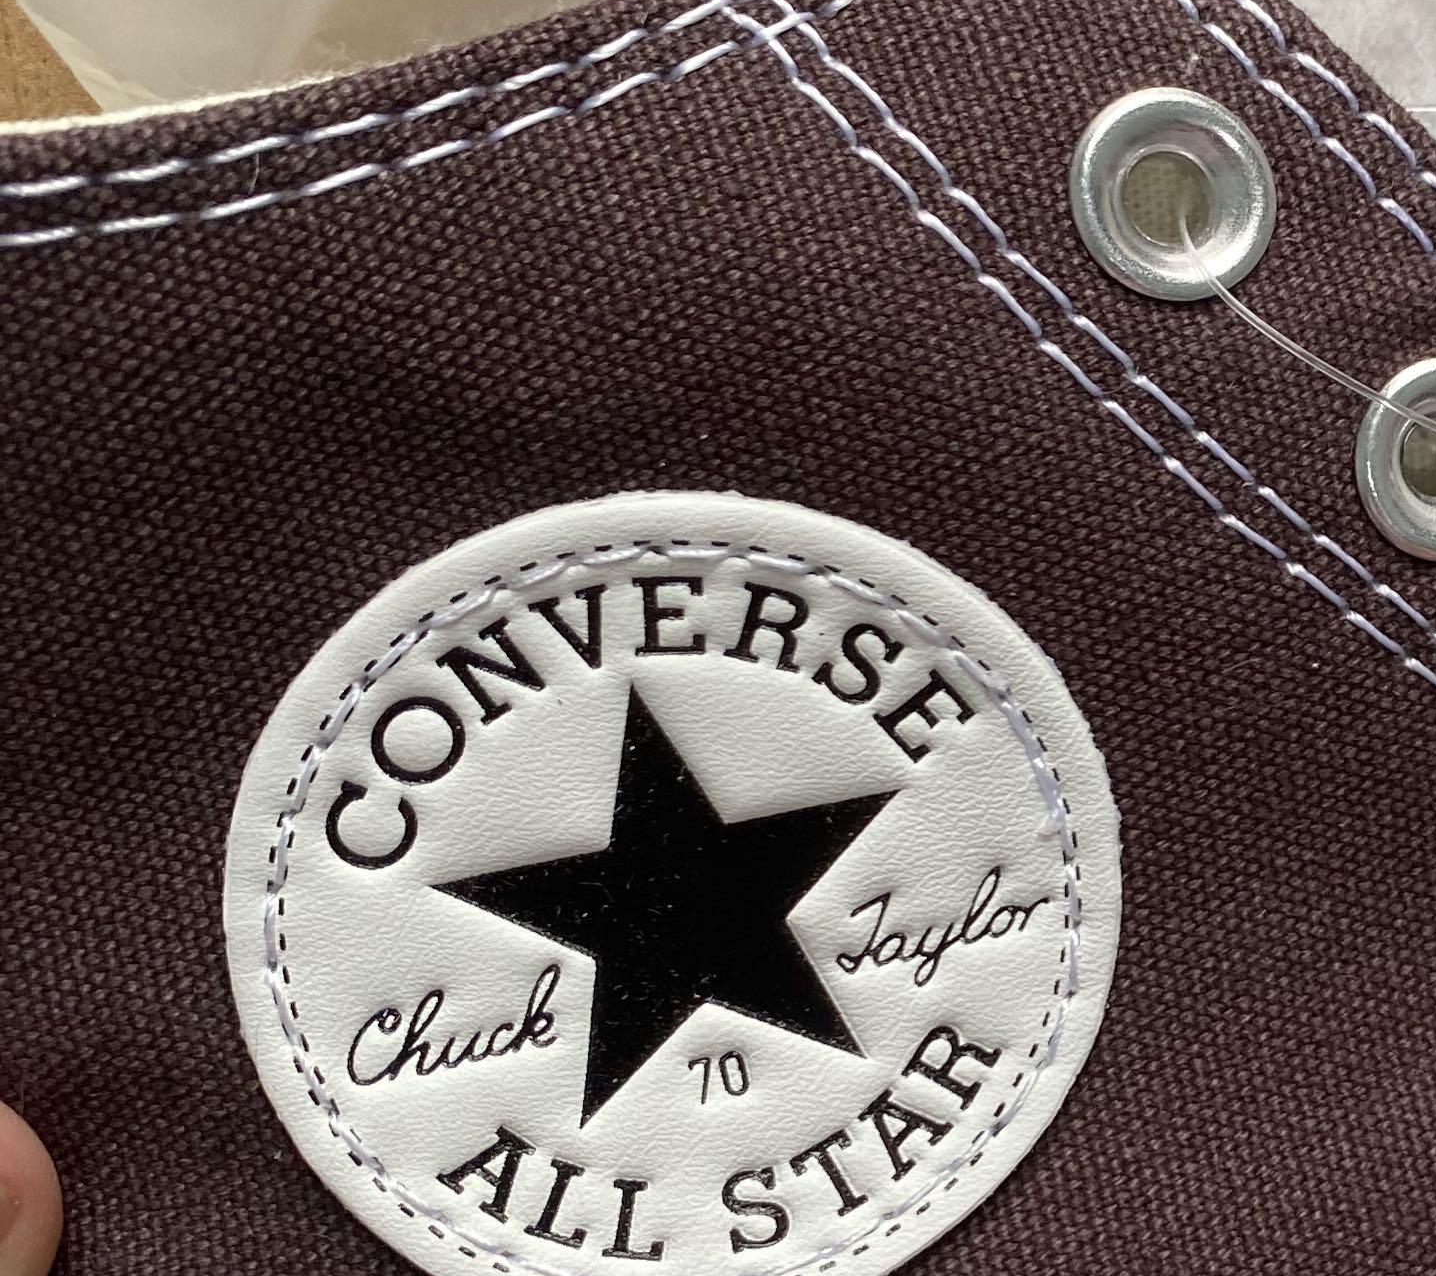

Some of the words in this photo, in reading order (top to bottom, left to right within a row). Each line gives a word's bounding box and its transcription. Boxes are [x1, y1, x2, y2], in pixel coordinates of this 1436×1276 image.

[325, 575, 976, 869] CONVERSE
[347, 964, 560, 1086] Chuck
[836, 866, 1049, 986] Taylor
[688, 1051, 751, 1105] 70
[436, 1126, 665, 1262] ALL
[720, 1023, 1004, 1254] STAR
